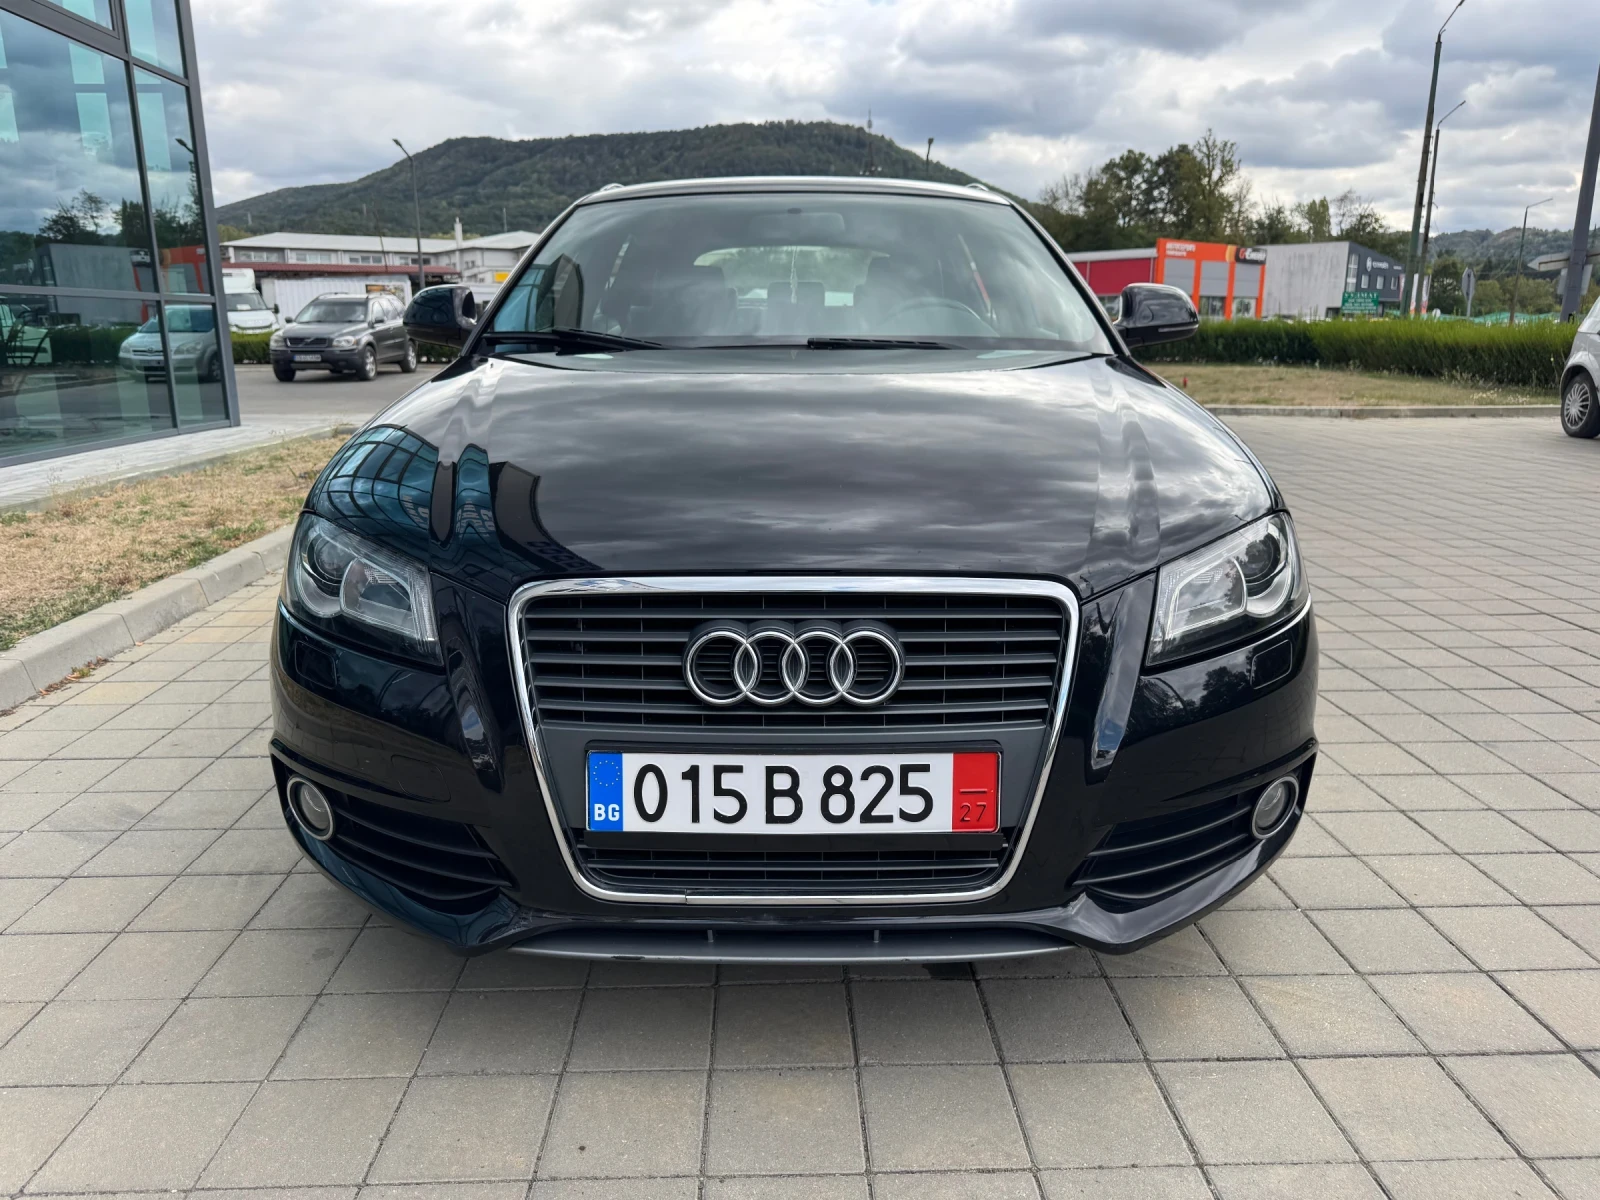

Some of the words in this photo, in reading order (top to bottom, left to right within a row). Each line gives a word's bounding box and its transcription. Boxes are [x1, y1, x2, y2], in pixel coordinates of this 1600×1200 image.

[633, 763, 748, 824] 015
[765, 765, 803, 824] B
[820, 763, 934, 824] 825
[594, 803, 620, 821] BG
[959, 802, 988, 822] 27
